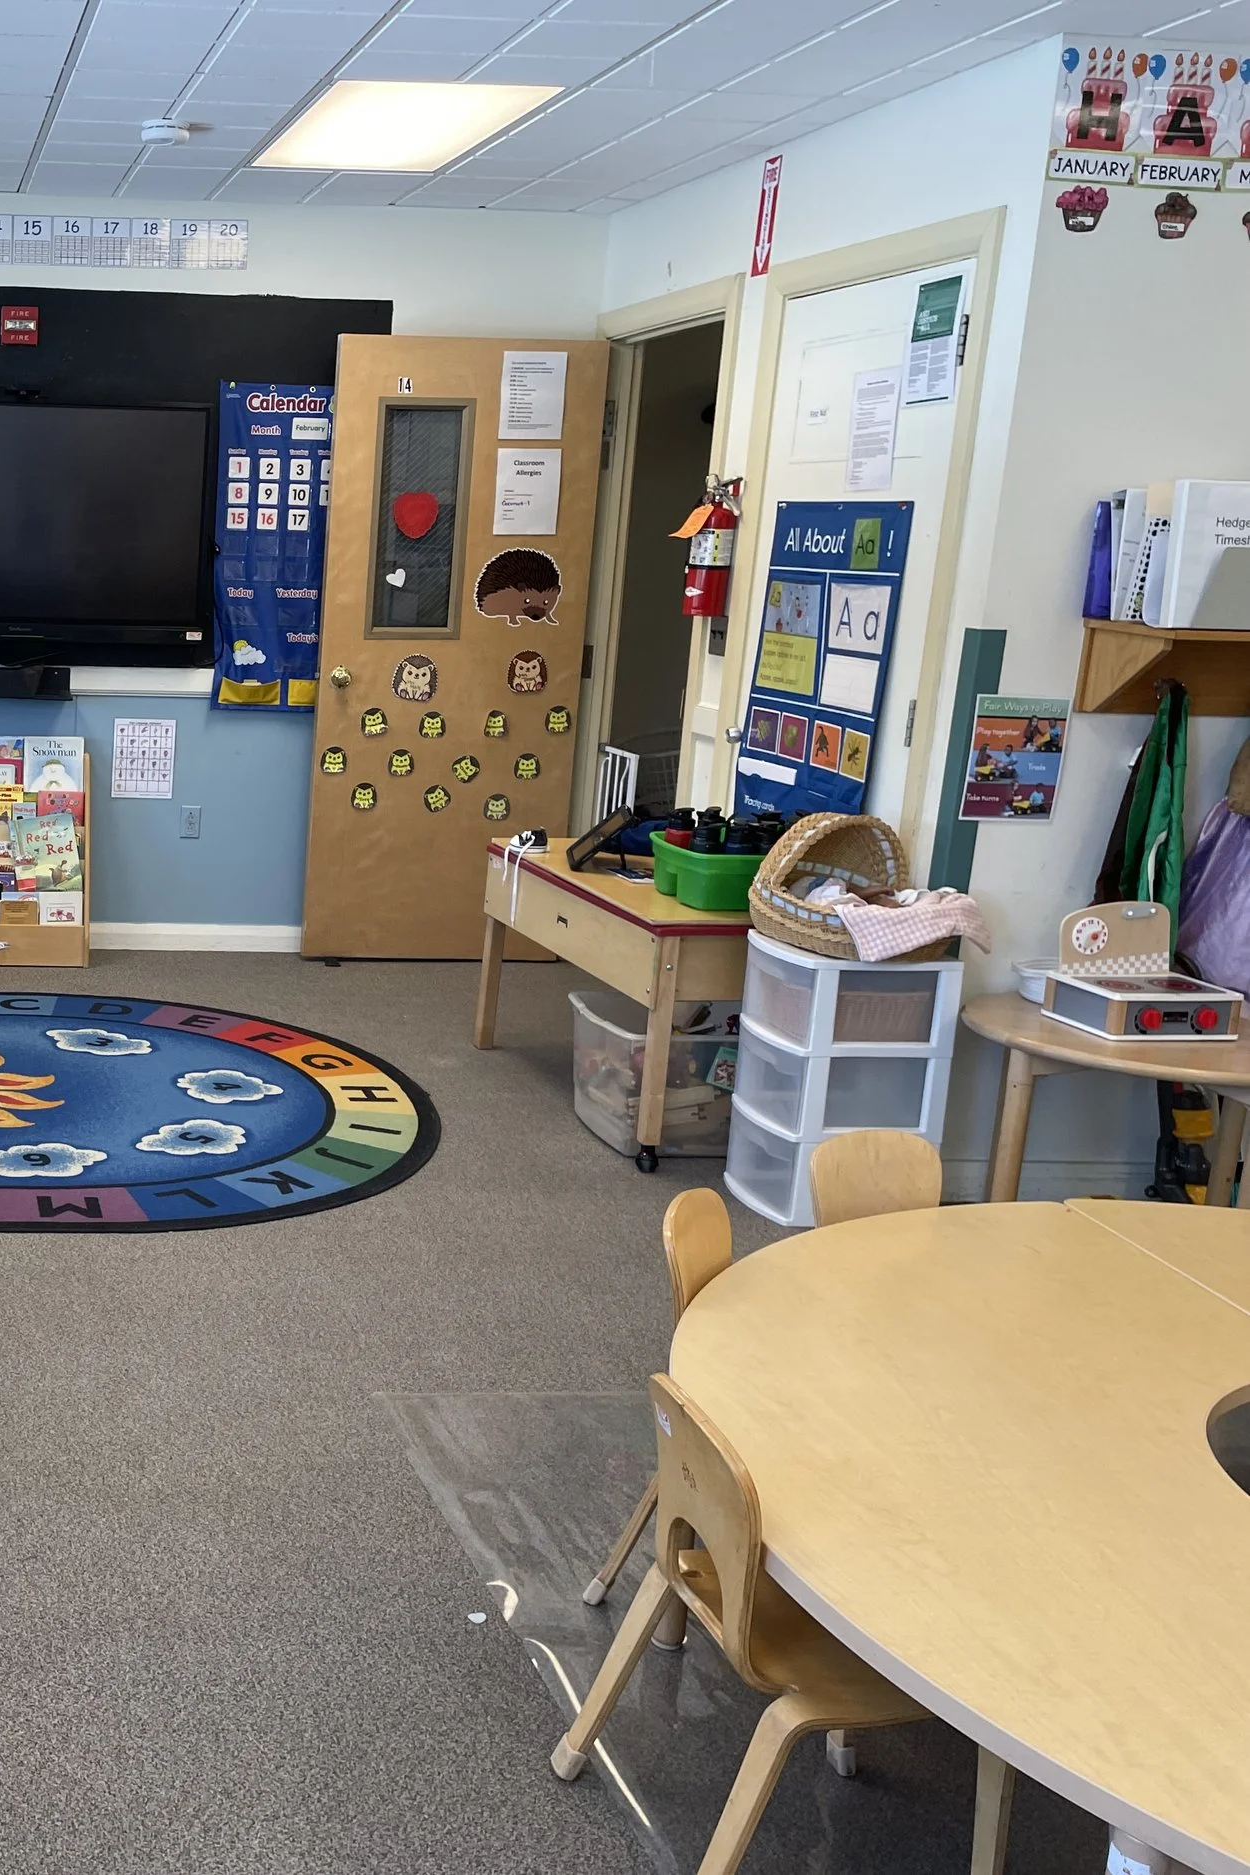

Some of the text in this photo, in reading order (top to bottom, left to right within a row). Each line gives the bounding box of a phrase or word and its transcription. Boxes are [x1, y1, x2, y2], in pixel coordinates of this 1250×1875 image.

[1076, 90, 1206, 147] H A
[1054, 157, 1130, 178] JANUARY
[1140, 164, 1221, 182] FEBRUARY
[23, 220, 42, 236] 15
[64, 220, 80, 234] 16
[104, 221, 120, 234] 17
[143, 223, 158, 235] 18
[182, 223, 198, 237] 19
[220, 223, 238, 237] 20
[399, 378, 412, 392] 14
[248, 393, 326, 412] Calendar
[251, 424, 326, 436] Month February
[237, 462, 304, 476] 1 2 3
[513, 459, 545, 467] Classroom
[516, 469, 542, 477] Allergies
[235, 487, 306, 501] 8 9 10
[231, 513, 305, 526] 15 16 17
[785, 528, 800, 551] All
[803, 528, 846, 554] About
[855, 533, 875, 556] Aa
[227, 587, 318, 599] Today Yesterday
[835, 597, 880, 641] A a
[286, 633, 318, 645] Today's
[984, 701, 1000, 711] Fair
[1004, 702, 1028, 712] Ways
[1042, 703, 1062, 714] Play
[992, 728, 1020, 738] together
[47, 740, 63, 750] The
[32, 747, 77, 758] Snowman
[744, 795, 761, 810] Tracing
[40, 819, 57, 829] Red
[26, 832, 49, 844] Red
[46, 841, 73, 855] Red
[0, 998, 39, 1010] C
[88, 1003, 133, 1016] D
[178, 1014, 224, 1029] E
[86, 1037, 114, 1048] 3
[245, 1031, 295, 1044] F
[301, 1053, 354, 1071] G
[213, 1082, 243, 1092] 4
[340, 1085, 399, 1102] H
[349, 1124, 402, 1135] I
[179, 1132, 211, 1144] 5
[314, 1147, 375, 1169] J
[247, 1171, 315, 1195] K
[155, 1188, 218, 1209] L
[36, 1196, 104, 1219] M
